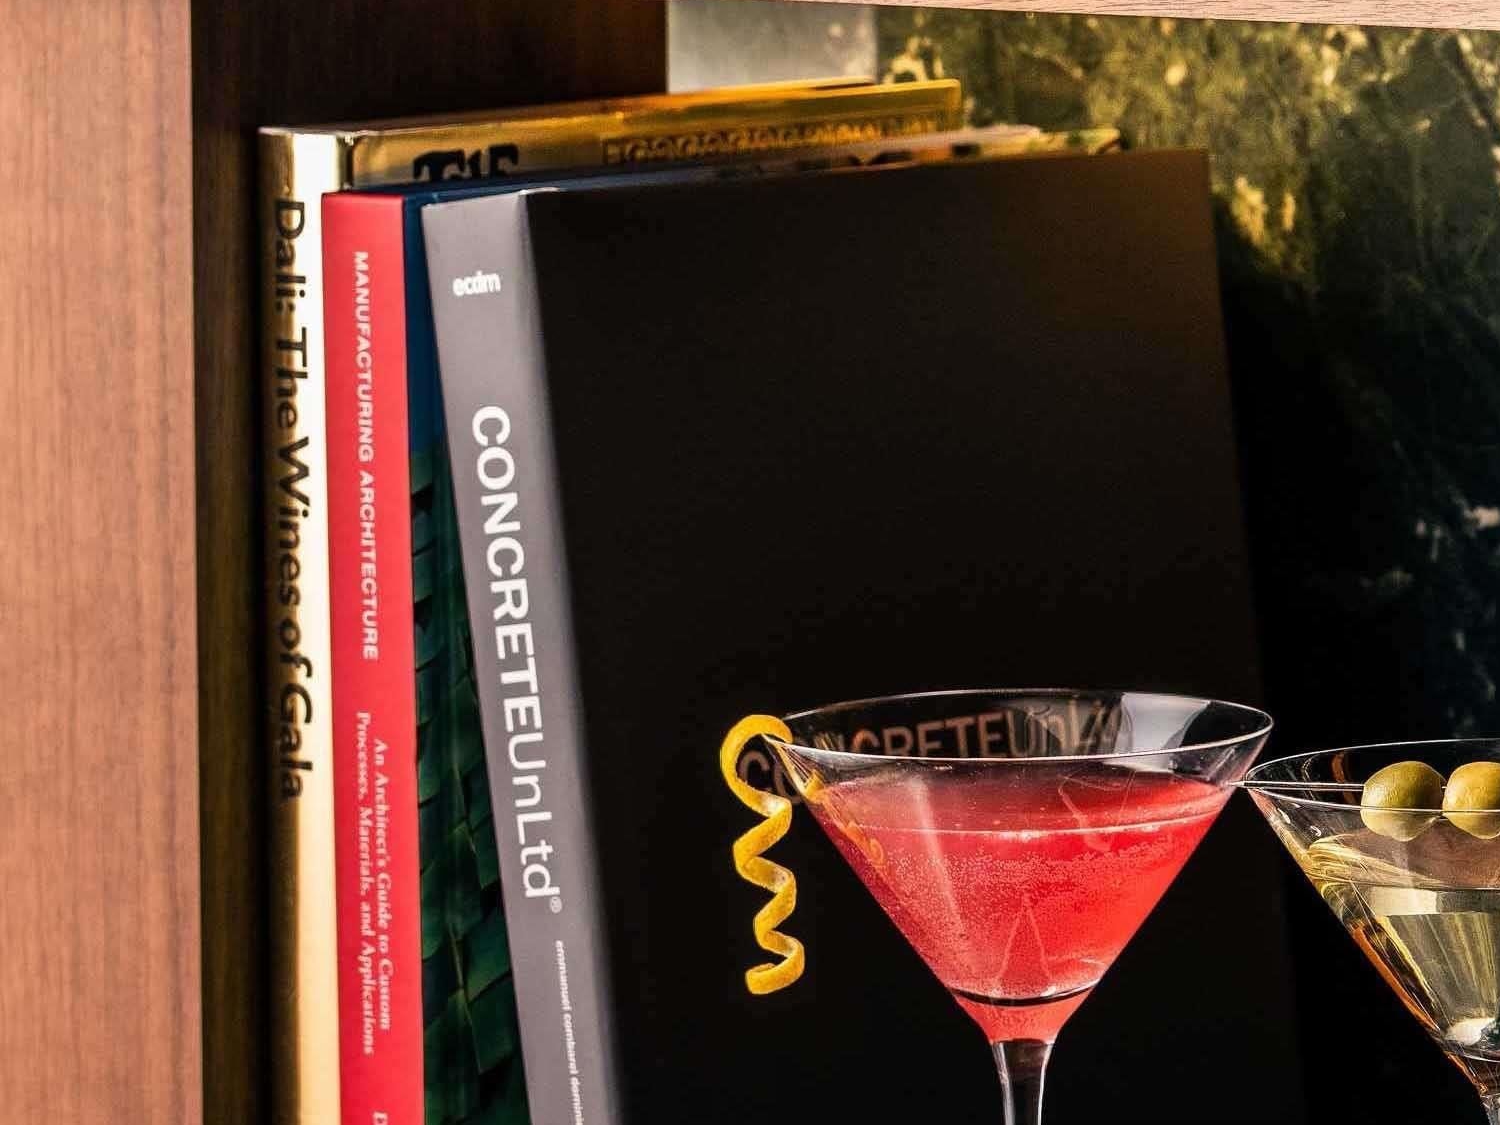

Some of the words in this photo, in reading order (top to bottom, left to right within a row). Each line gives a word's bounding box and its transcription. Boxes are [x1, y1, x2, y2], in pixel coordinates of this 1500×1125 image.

[276, 327, 309, 430] The
[352, 250, 375, 463] MANUFACTURING
[278, 435, 311, 606] Wines
[357, 471, 379, 660] ARCHITECTURE
[279, 618, 314, 679] of
[280, 687, 314, 798] Gala
[359, 901, 376, 937] and
[377, 874, 393, 930] Guide
[378, 934, 390, 955] to
[357, 942, 378, 1056] Applications
[378, 960, 395, 1031] Custom
